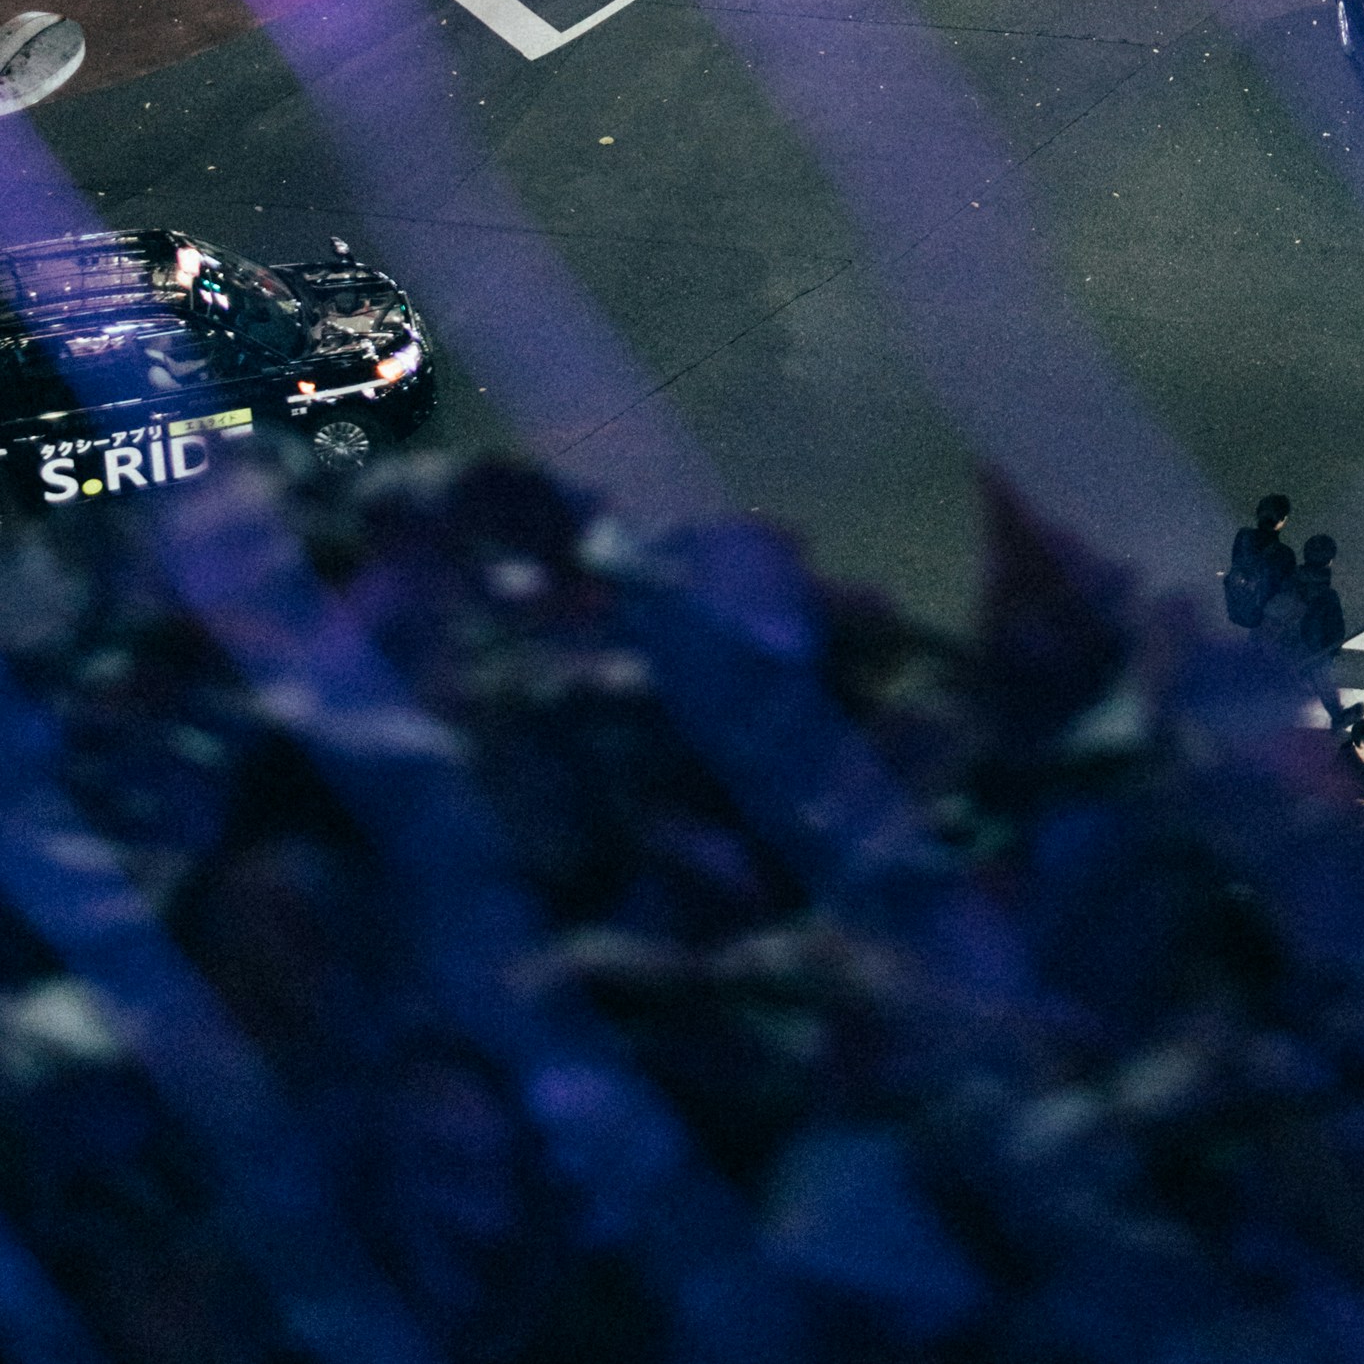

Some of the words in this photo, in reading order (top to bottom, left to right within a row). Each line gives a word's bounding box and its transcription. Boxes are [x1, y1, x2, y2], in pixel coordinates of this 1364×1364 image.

[40, 424, 163, 460] タクシーアプリ
[40, 434, 210, 504] S.RID
